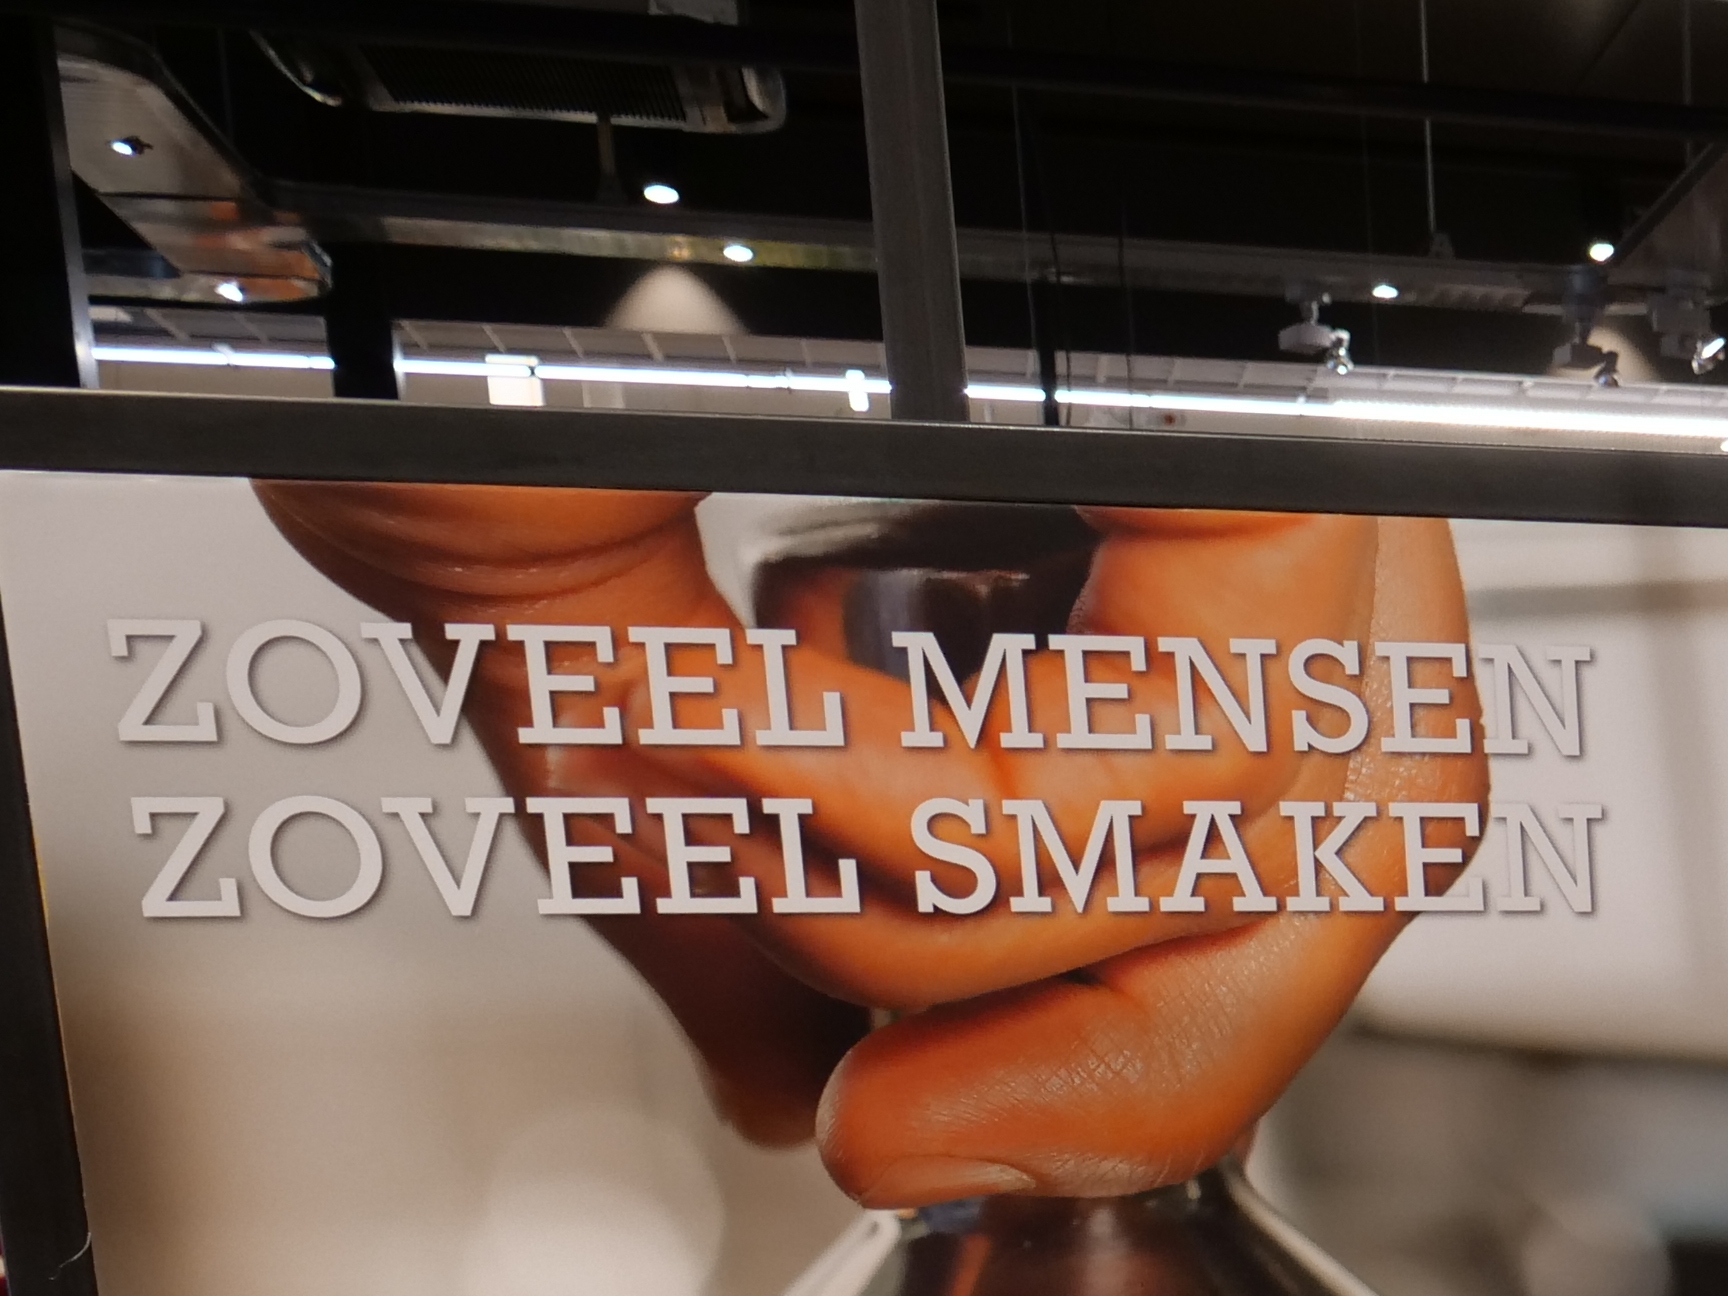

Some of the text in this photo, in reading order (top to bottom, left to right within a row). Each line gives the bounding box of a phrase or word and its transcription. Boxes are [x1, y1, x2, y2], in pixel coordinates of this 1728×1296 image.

[105, 617, 1594, 757] ZOVEEL MENSEN
[130, 794, 1605, 920] ZOVEEL SMAKEN
